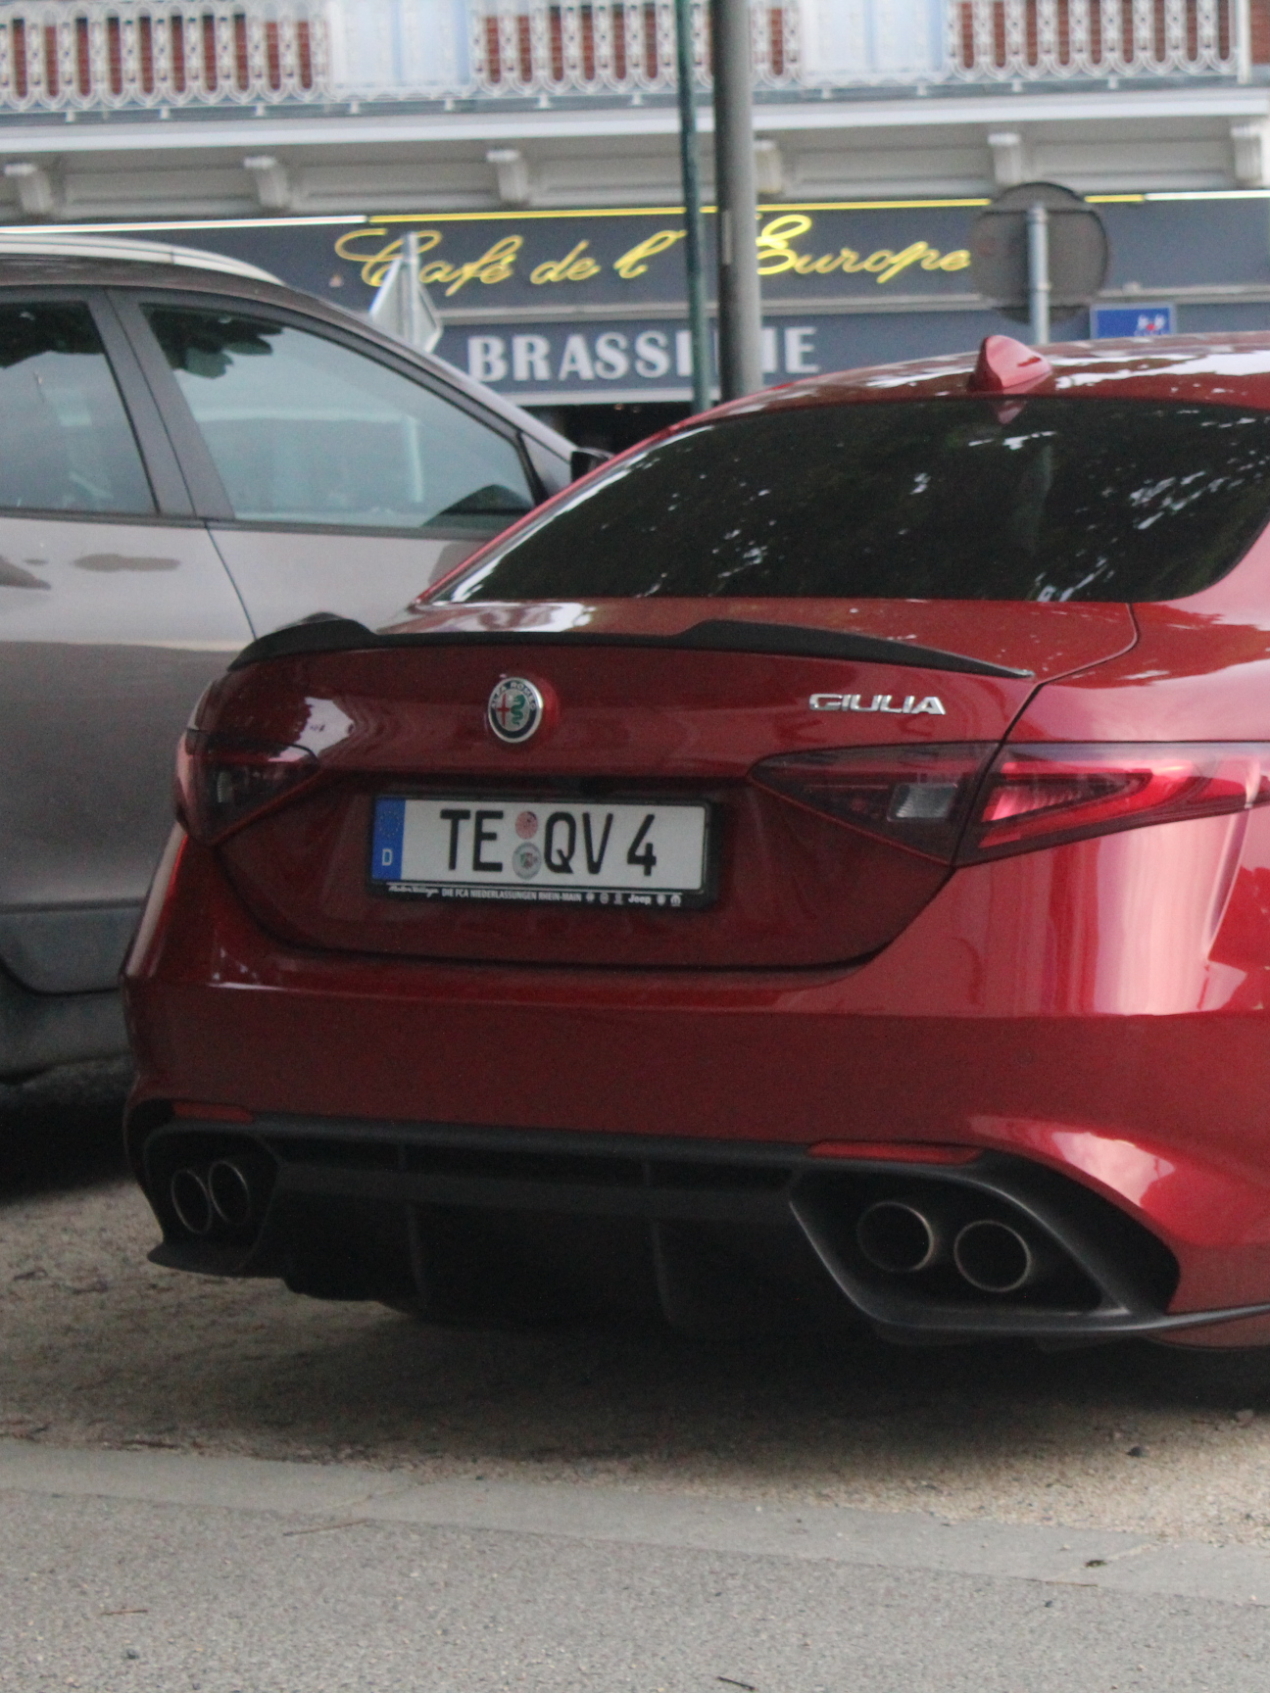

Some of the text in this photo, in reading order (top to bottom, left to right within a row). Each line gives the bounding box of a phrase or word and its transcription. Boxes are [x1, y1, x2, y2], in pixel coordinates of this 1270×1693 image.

[335, 228, 523, 297] Café
[530, 239, 600, 284] de
[755, 214, 971, 283] Europe
[467, 325, 822, 383] BRASSIE
[809, 693, 946, 715] GIULIA
[382, 849, 393, 866] D
[440, 809, 657, 876] TE QV 4
[628, 893, 652, 906] Jeep
